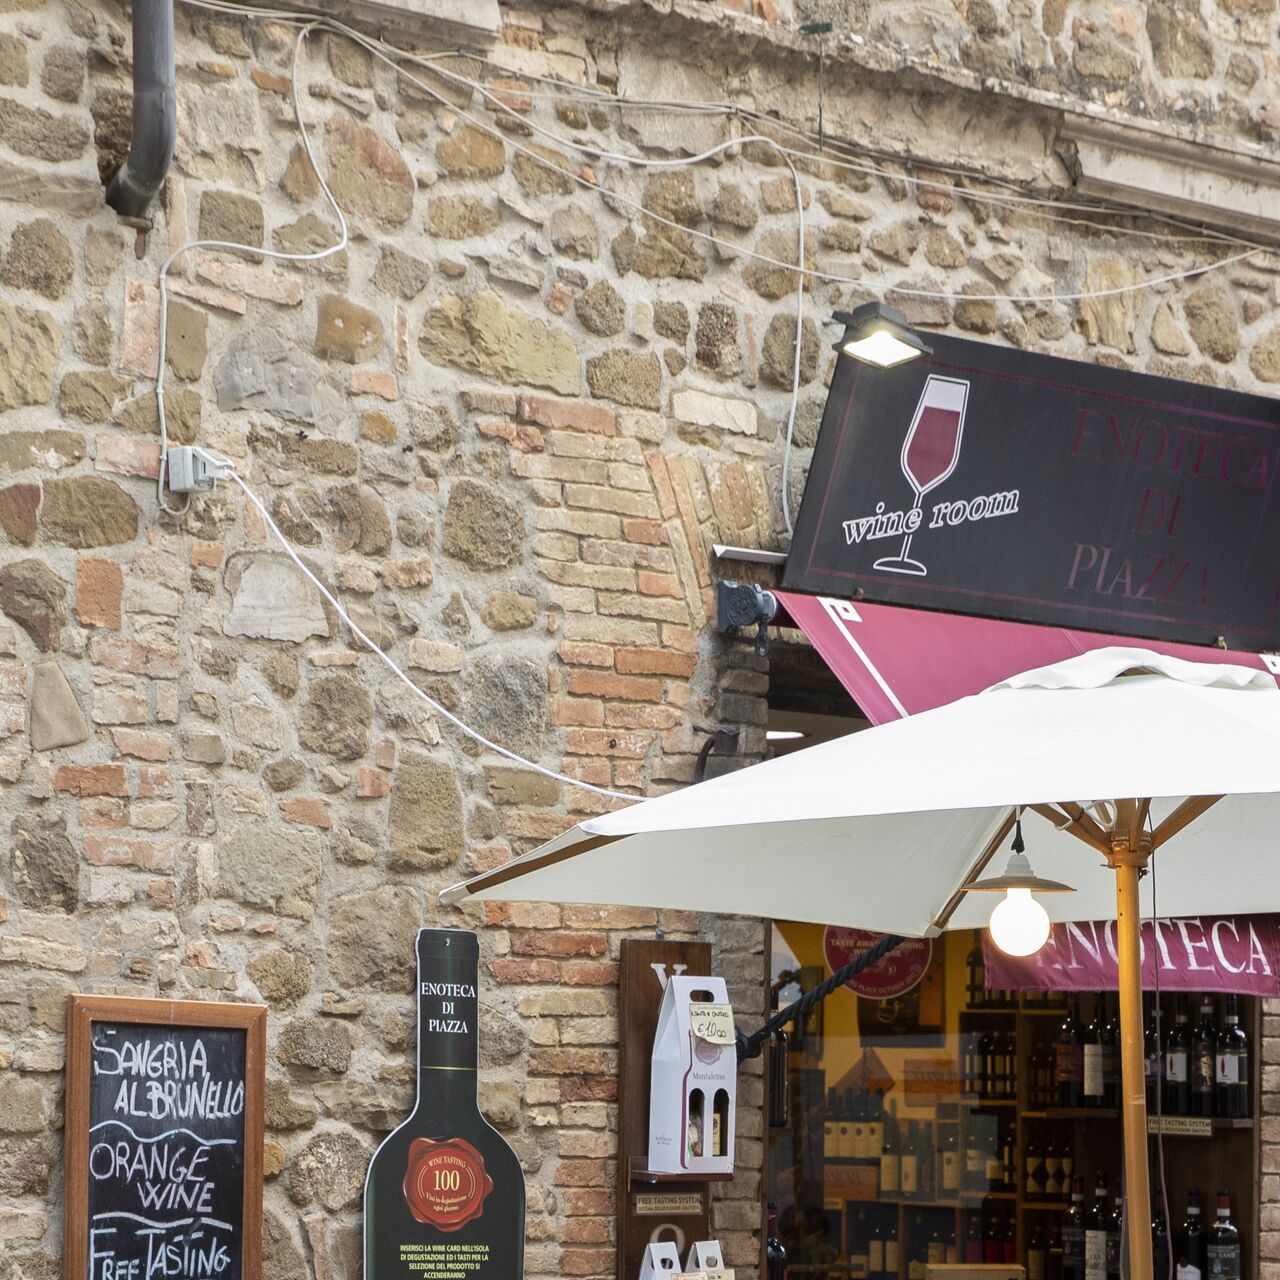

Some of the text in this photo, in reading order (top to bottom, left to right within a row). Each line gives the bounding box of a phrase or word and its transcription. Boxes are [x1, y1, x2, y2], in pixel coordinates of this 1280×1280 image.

[1070, 408, 1274, 490] ENOTECA
[843, 488, 1020, 546] wine room
[1134, 488, 1184, 540] DI
[1065, 542, 1211, 607] PIAZZA
[420, 982, 476, 998] ENOTECA
[442, 1001, 455, 1015] DI
[428, 1019, 468, 1034] PIAZZA
[91, 1031, 208, 1080] SANGRIA
[693, 1072, 726, 1080] Montalcino
[114, 1072, 245, 1120] AL BRUNELLO
[89, 1142, 211, 1183] ORANGE
[433, 1169, 460, 1191] 100
[443, 1156, 467, 1169] TASTING
[137, 1181, 215, 1213] WINE
